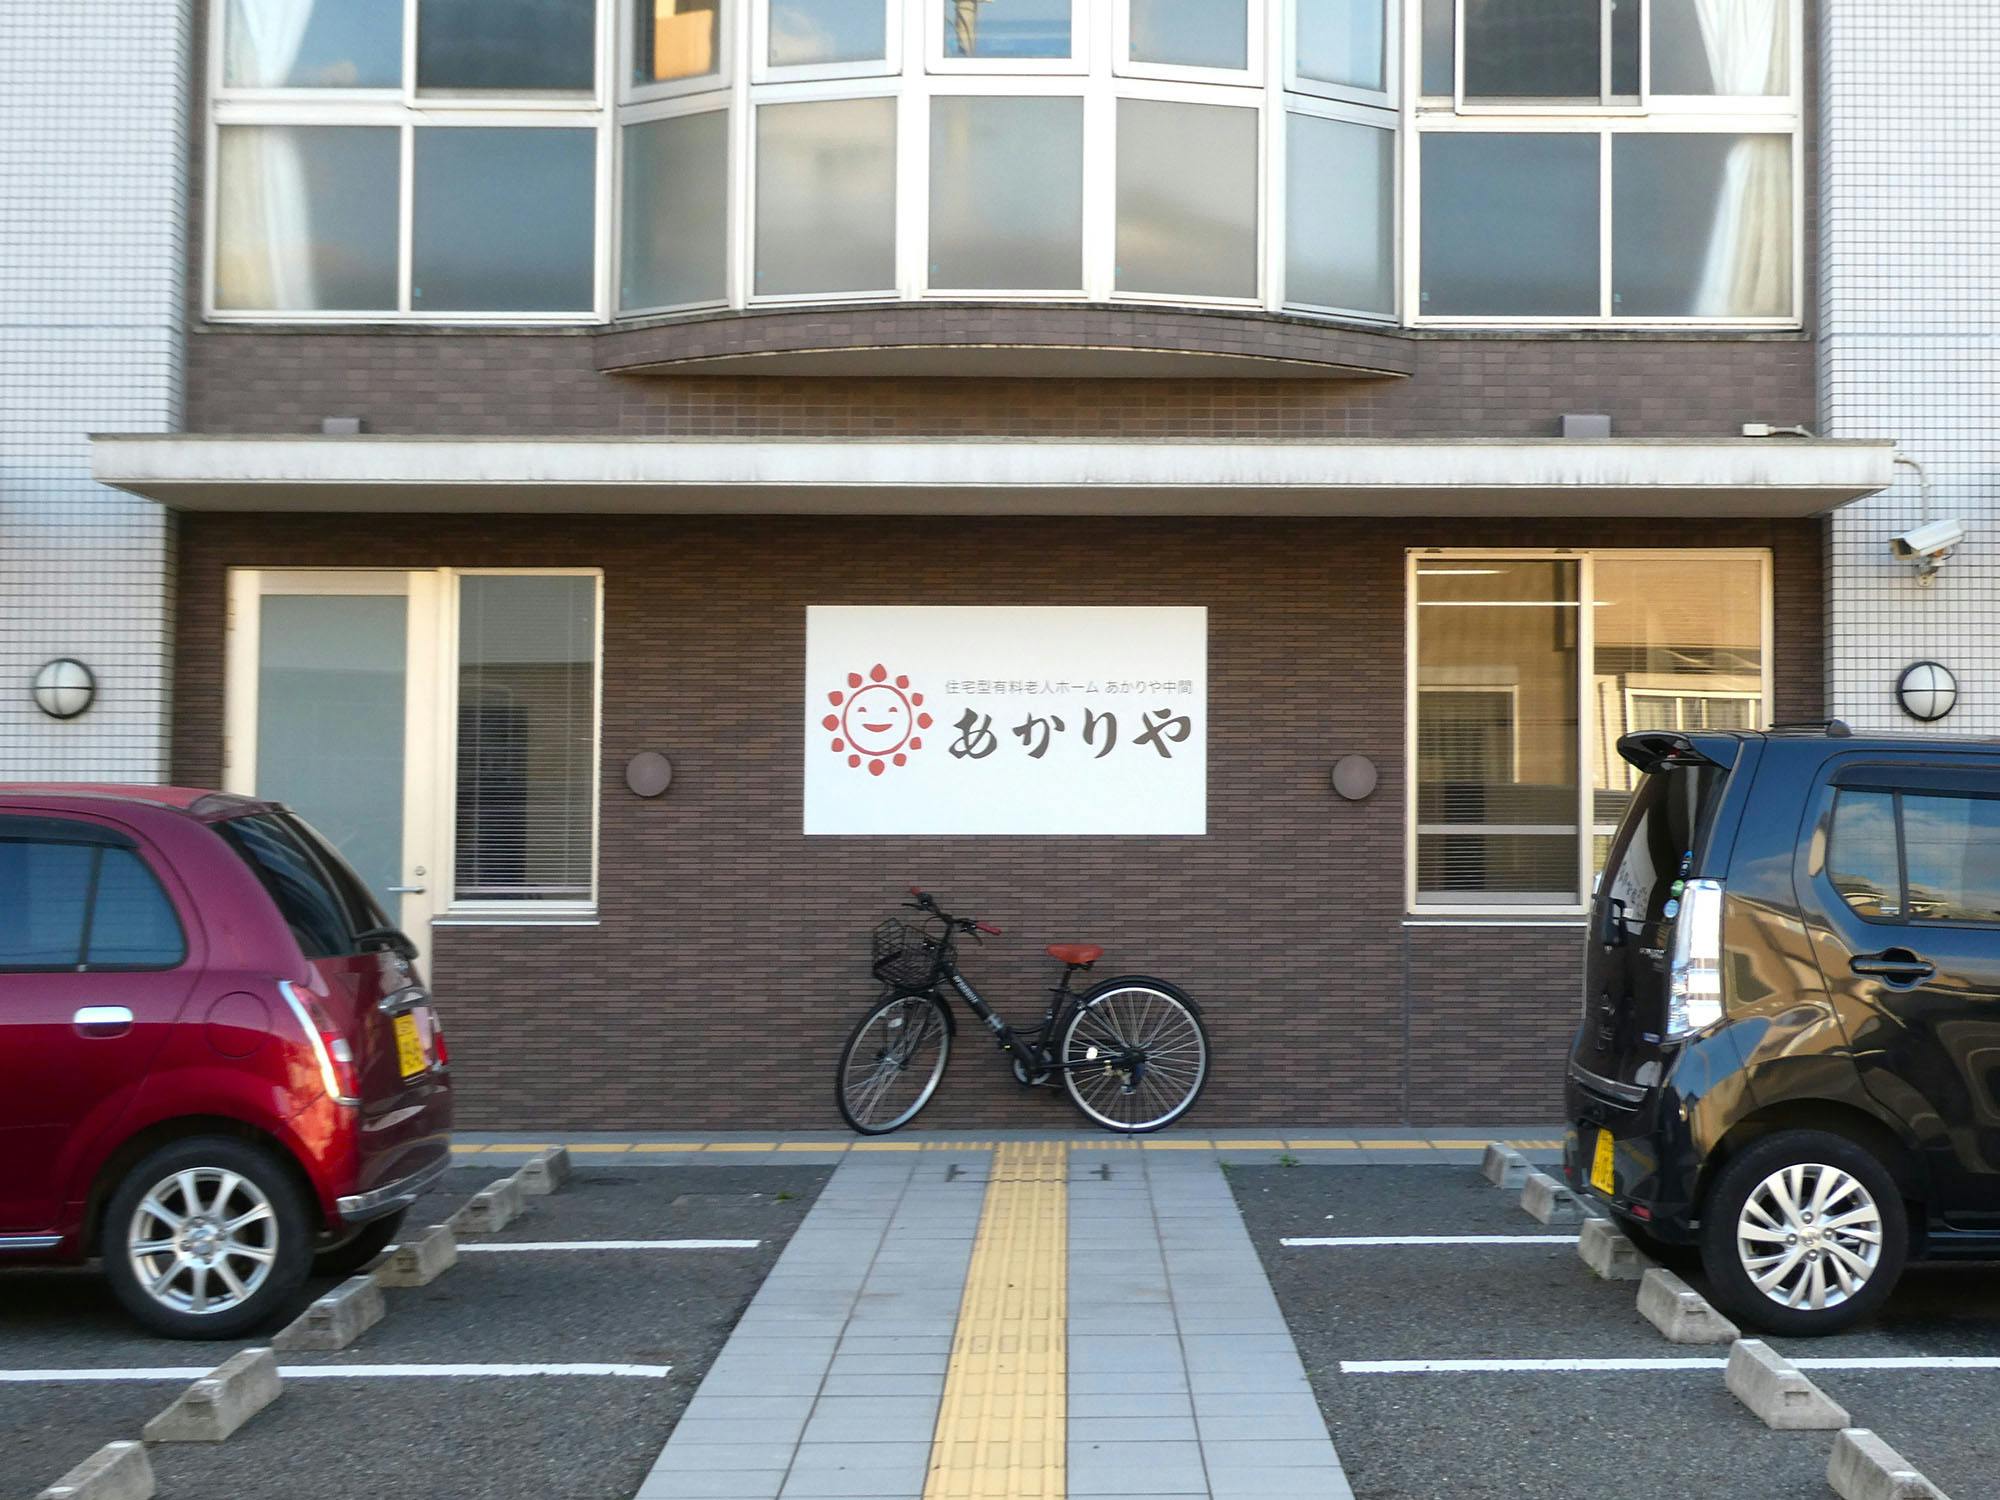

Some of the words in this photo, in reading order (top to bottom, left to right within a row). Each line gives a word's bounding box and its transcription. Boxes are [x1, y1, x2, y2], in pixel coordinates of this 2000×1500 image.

[945, 680, 1099, 695] 住宅型有料老人ホーム
[1104, 680, 1192, 695] あかりや中間
[948, 707, 1191, 759] あかりや
